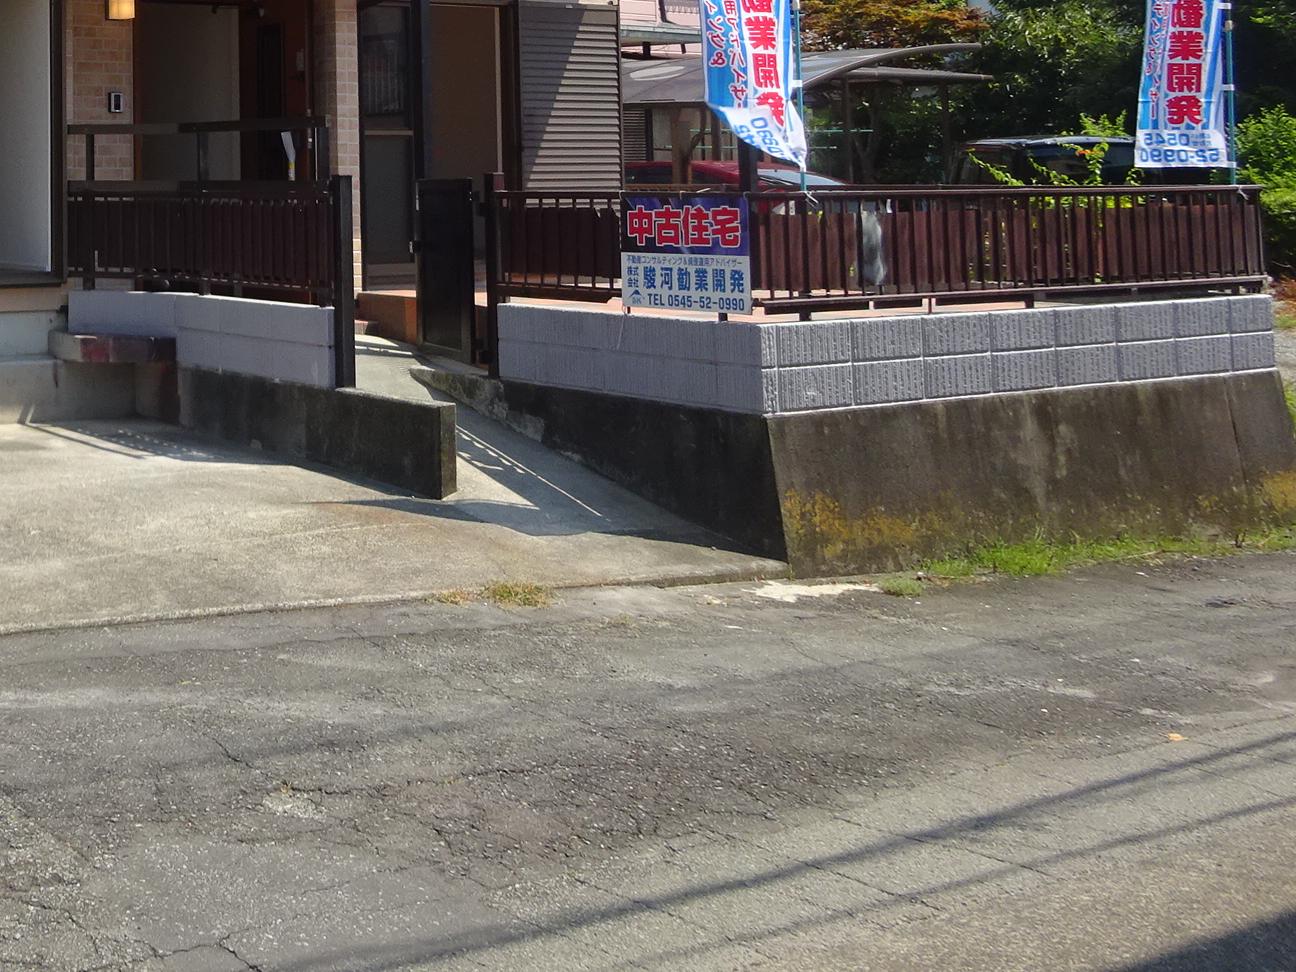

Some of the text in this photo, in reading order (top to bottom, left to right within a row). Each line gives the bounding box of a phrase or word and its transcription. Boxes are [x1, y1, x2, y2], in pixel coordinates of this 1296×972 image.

[627, 205, 741, 248] 中古住宅
[627, 266, 639, 277] 株式
[643, 266, 745, 294] 駿河勧業開発
[627, 278, 639, 288] 会社
[647, 293, 745, 311] TEL 0545-52-0990
